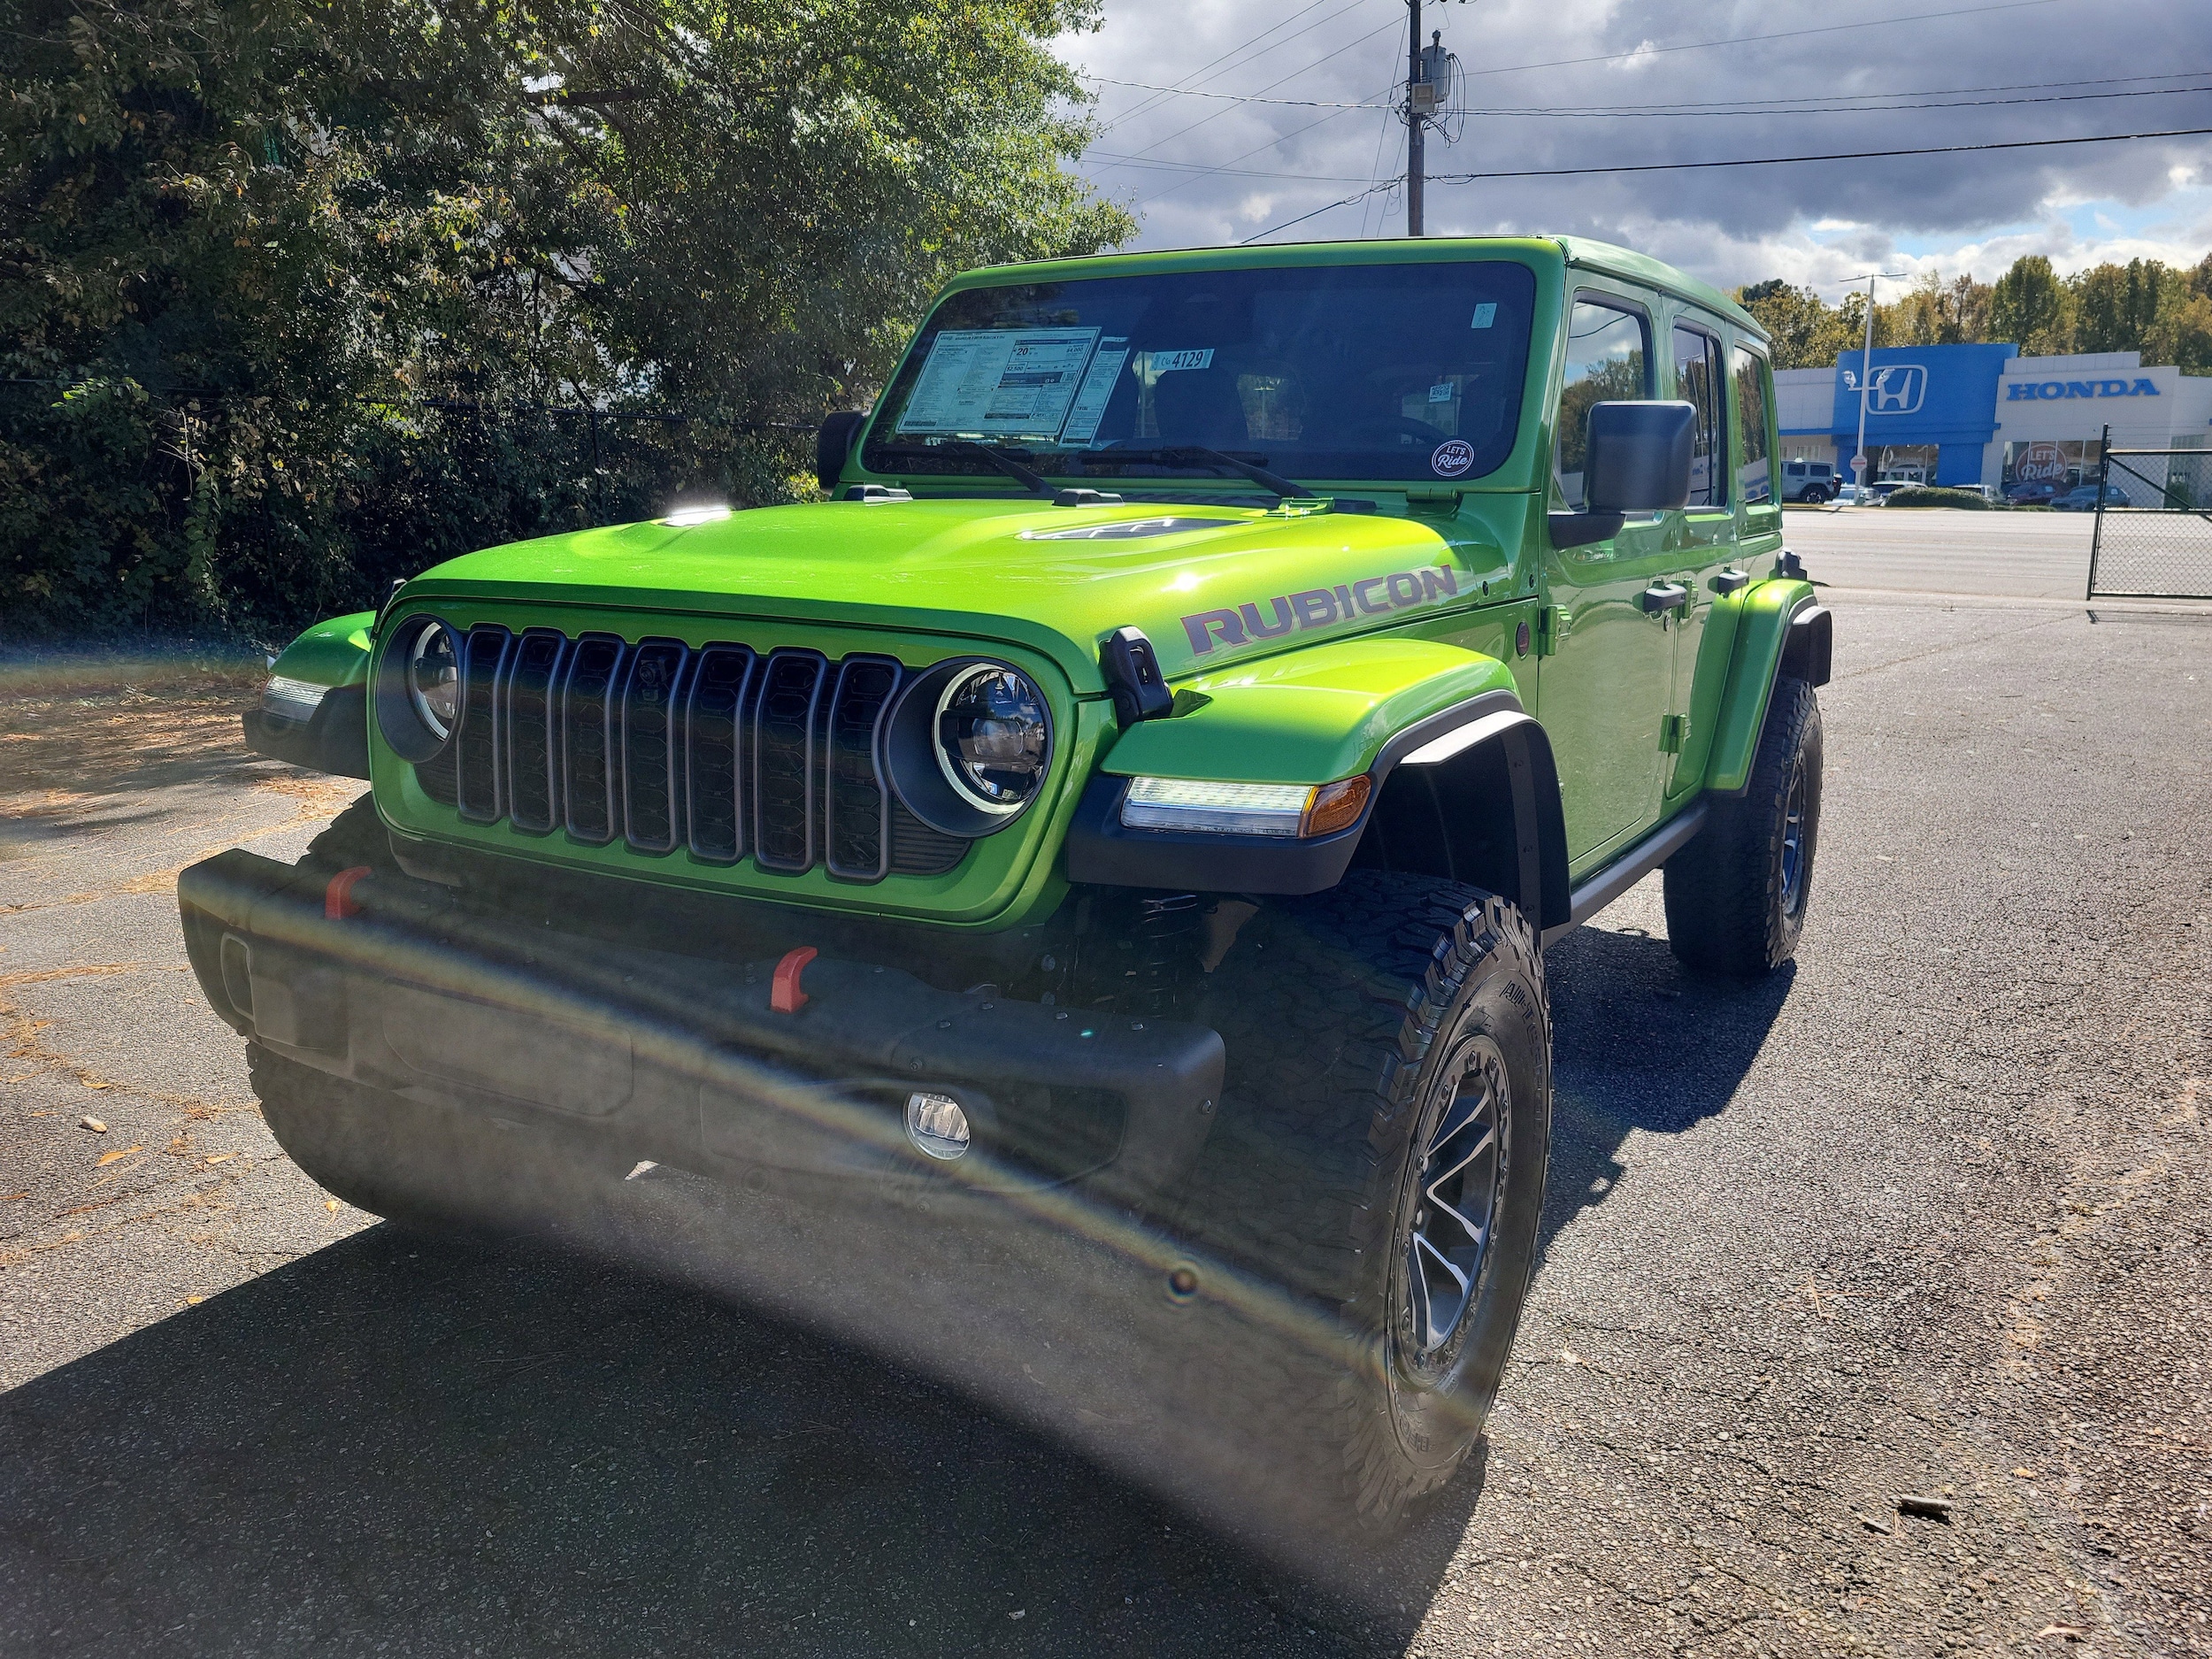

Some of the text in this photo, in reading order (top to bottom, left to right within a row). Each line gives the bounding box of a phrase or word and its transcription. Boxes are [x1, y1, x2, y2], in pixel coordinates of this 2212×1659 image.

[1016, 347, 1029, 356] 20
[1171, 350, 1204, 368] 4129
[2006, 378, 2161, 401] HONDA
[1446, 445, 1466, 456] LET'S
[2029, 449, 2055, 461] LET'S
[1437, 454, 1469, 469] Ride
[2020, 461, 2064, 480] Ride
[1179, 564, 1458, 657] RUBICON
